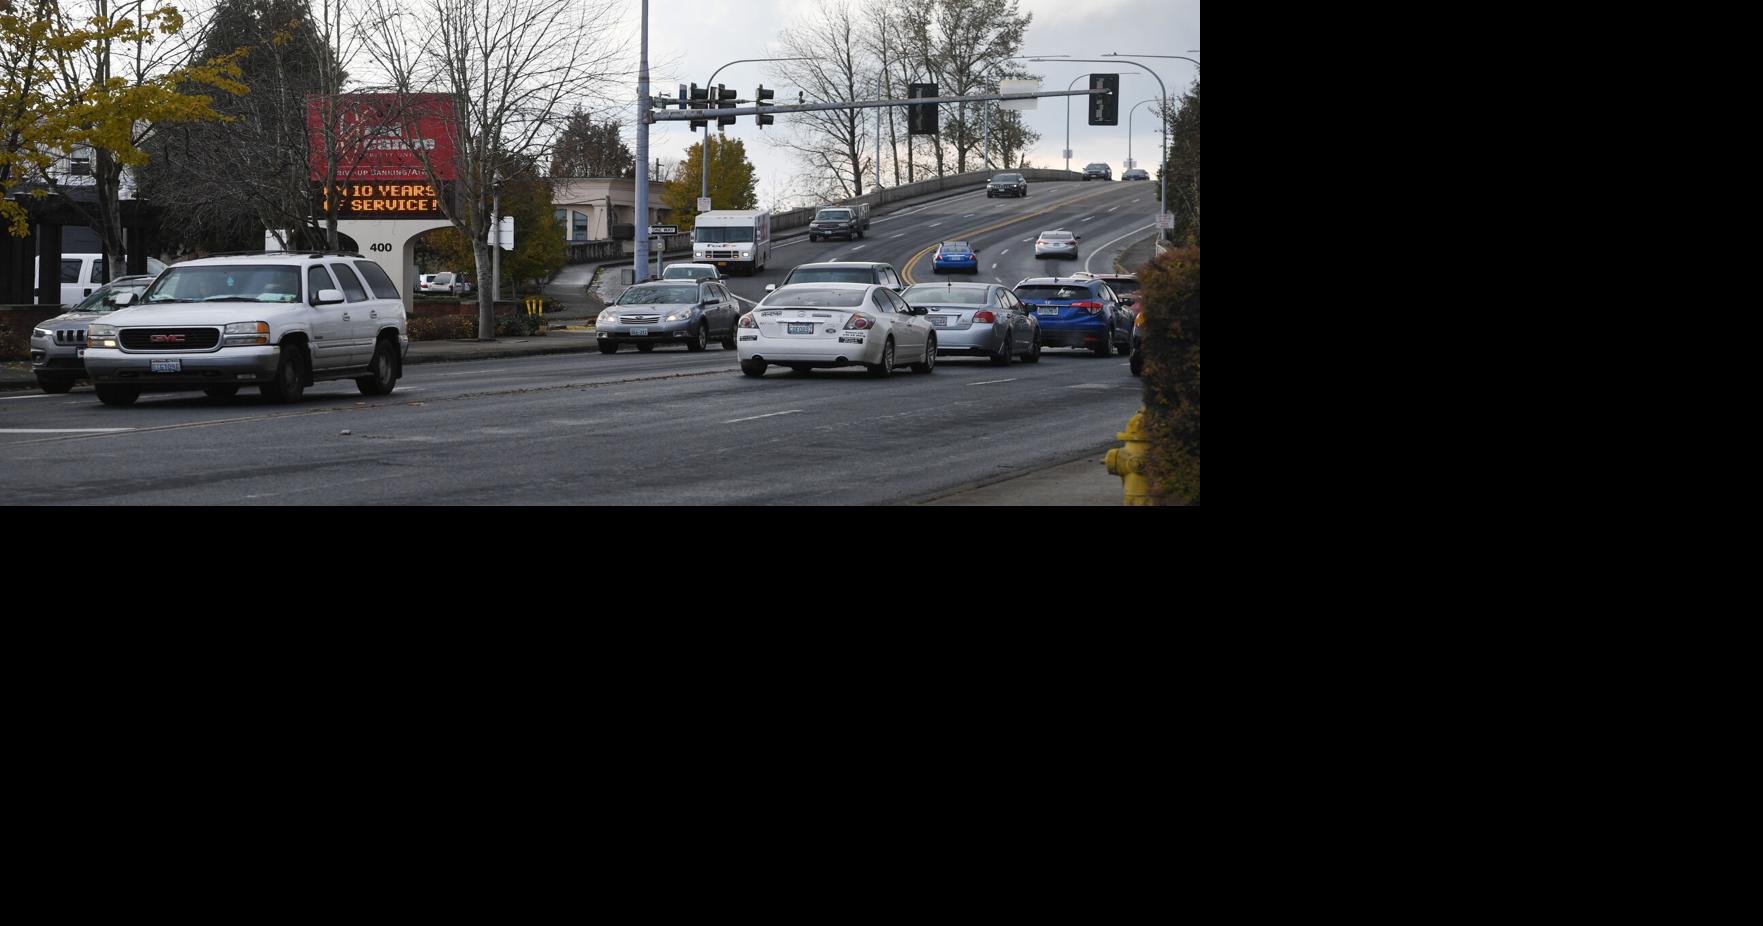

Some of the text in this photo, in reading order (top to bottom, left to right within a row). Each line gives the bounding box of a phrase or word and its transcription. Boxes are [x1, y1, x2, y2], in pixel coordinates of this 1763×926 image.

[352, 185, 373, 197] 10
[378, 185, 437, 197] YEARS
[369, 242, 392, 253] 400
[150, 334, 186, 343] GMC
